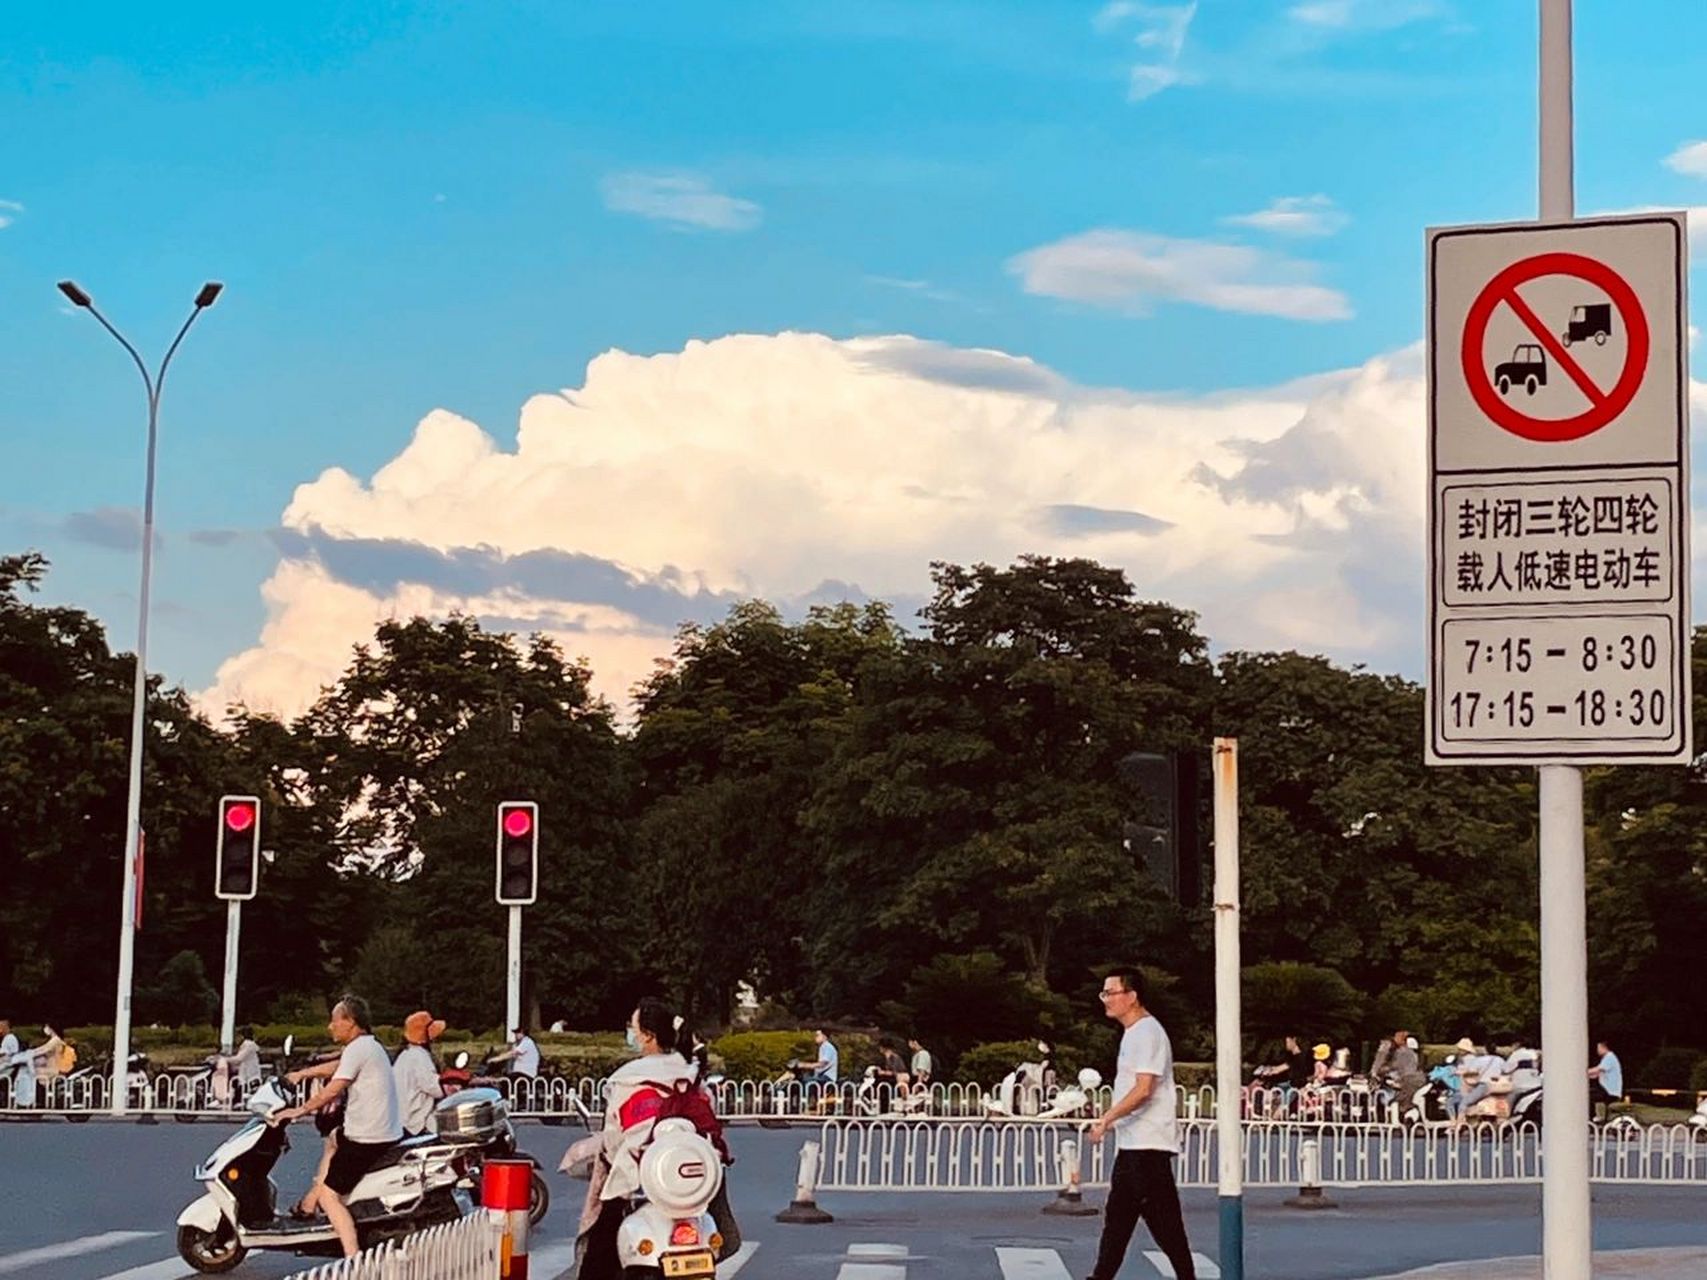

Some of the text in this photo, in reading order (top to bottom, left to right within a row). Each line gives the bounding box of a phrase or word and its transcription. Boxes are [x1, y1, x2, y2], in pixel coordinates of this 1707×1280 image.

[1458, 493, 1659, 540] 封闭三轮四轮
[1457, 546, 1661, 592] 载人低速电动车
[1465, 638, 1532, 674] 7:15
[1582, 634, 1656, 672] 8:30
[1450, 690, 1535, 728] 17:15
[1574, 688, 1665, 726] 18:30
